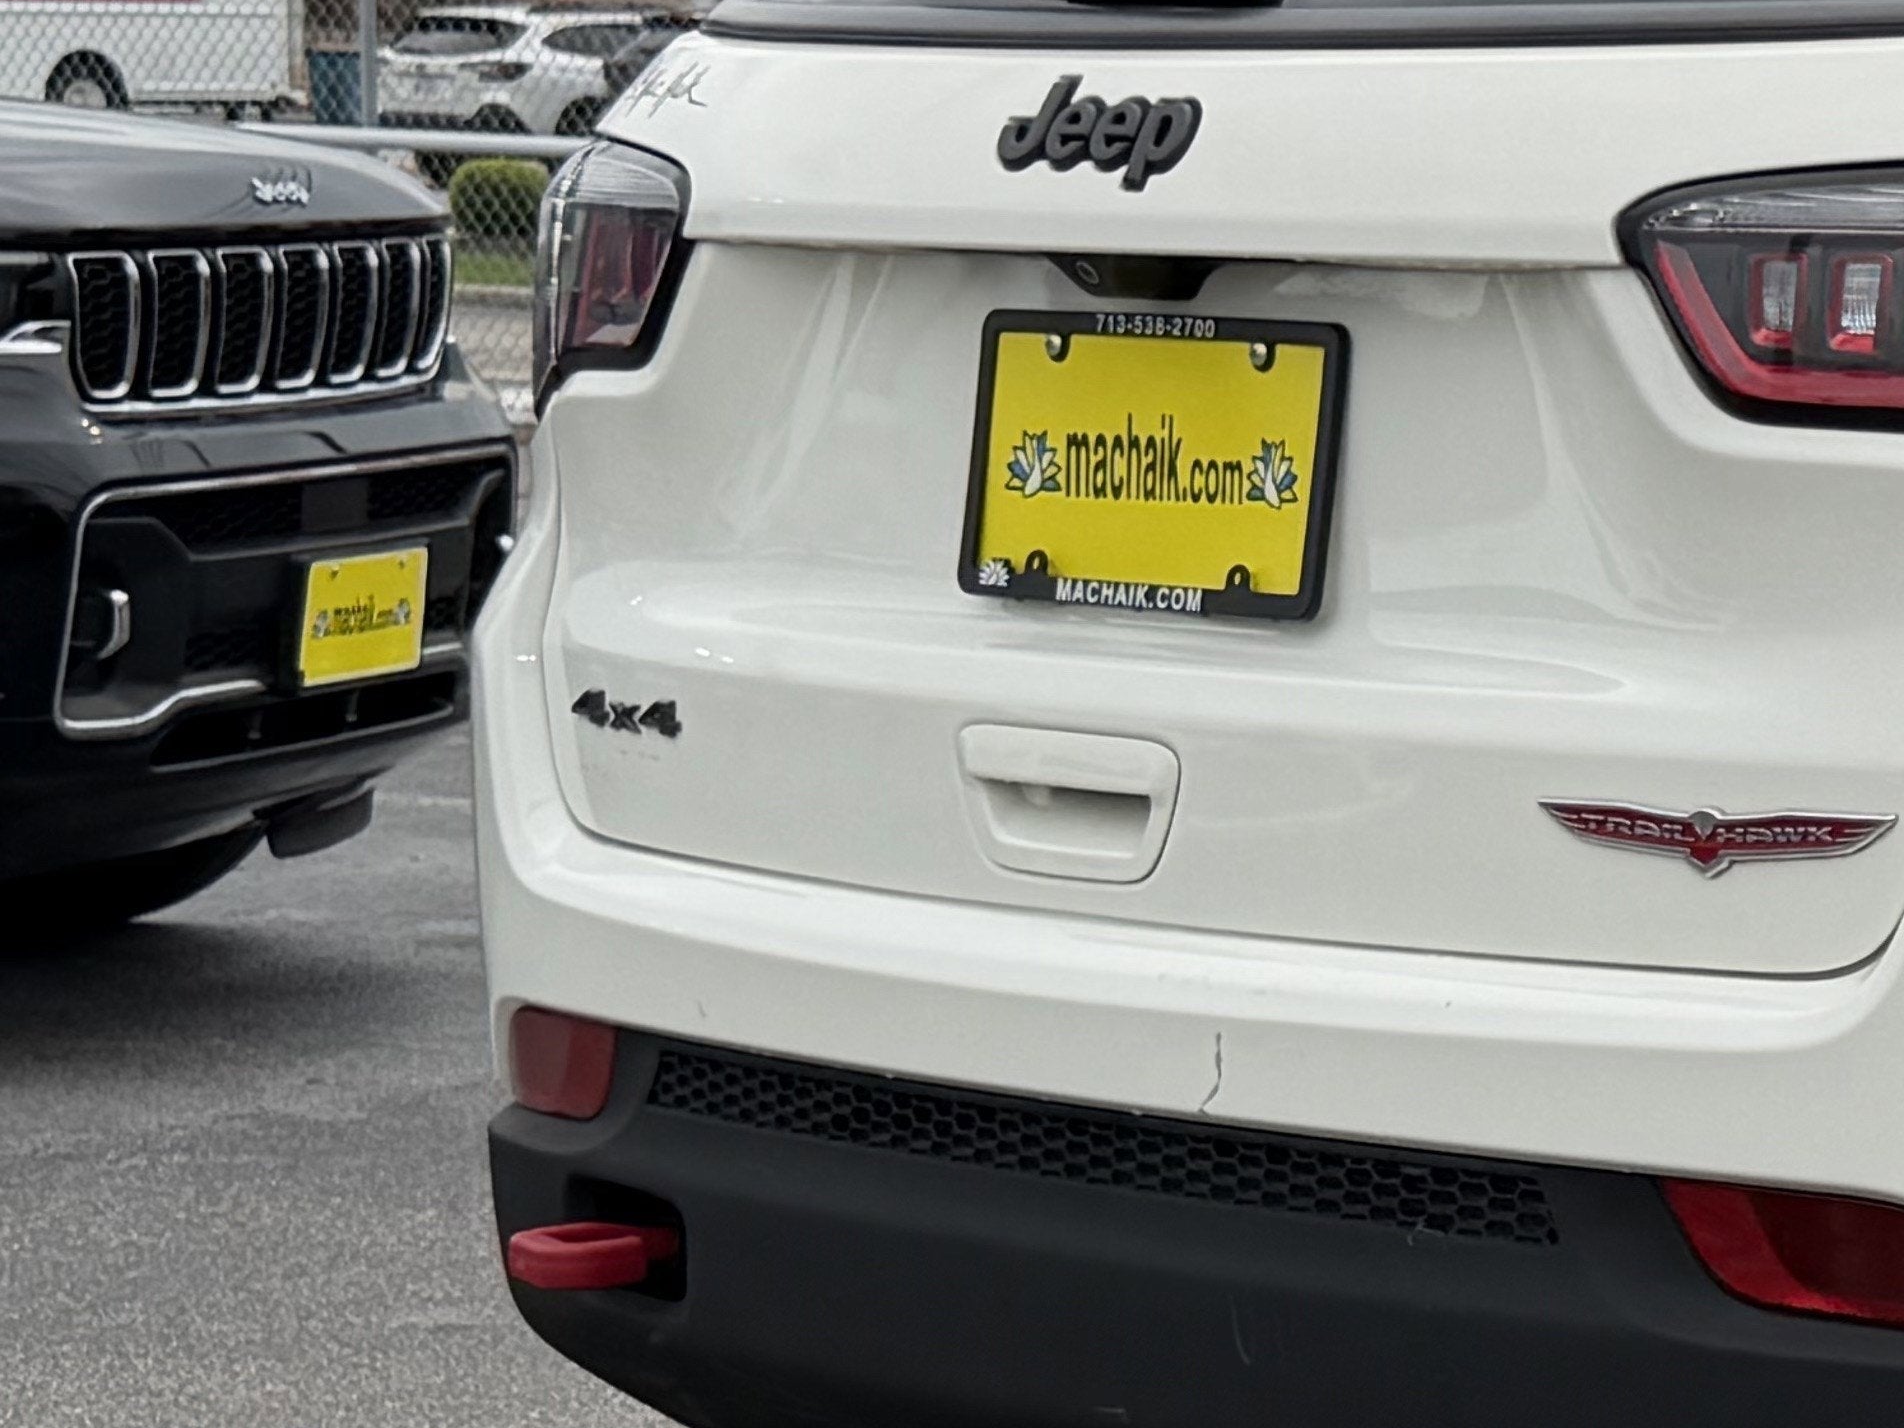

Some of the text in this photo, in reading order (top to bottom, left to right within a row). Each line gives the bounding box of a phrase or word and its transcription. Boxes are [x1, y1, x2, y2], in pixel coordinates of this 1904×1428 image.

[998, 74, 1203, 192] Jeep
[1065, 412, 1243, 505] machaik.com
[1055, 577, 1203, 612] MACHAIK.COM
[571, 689, 683, 739] 4x4
